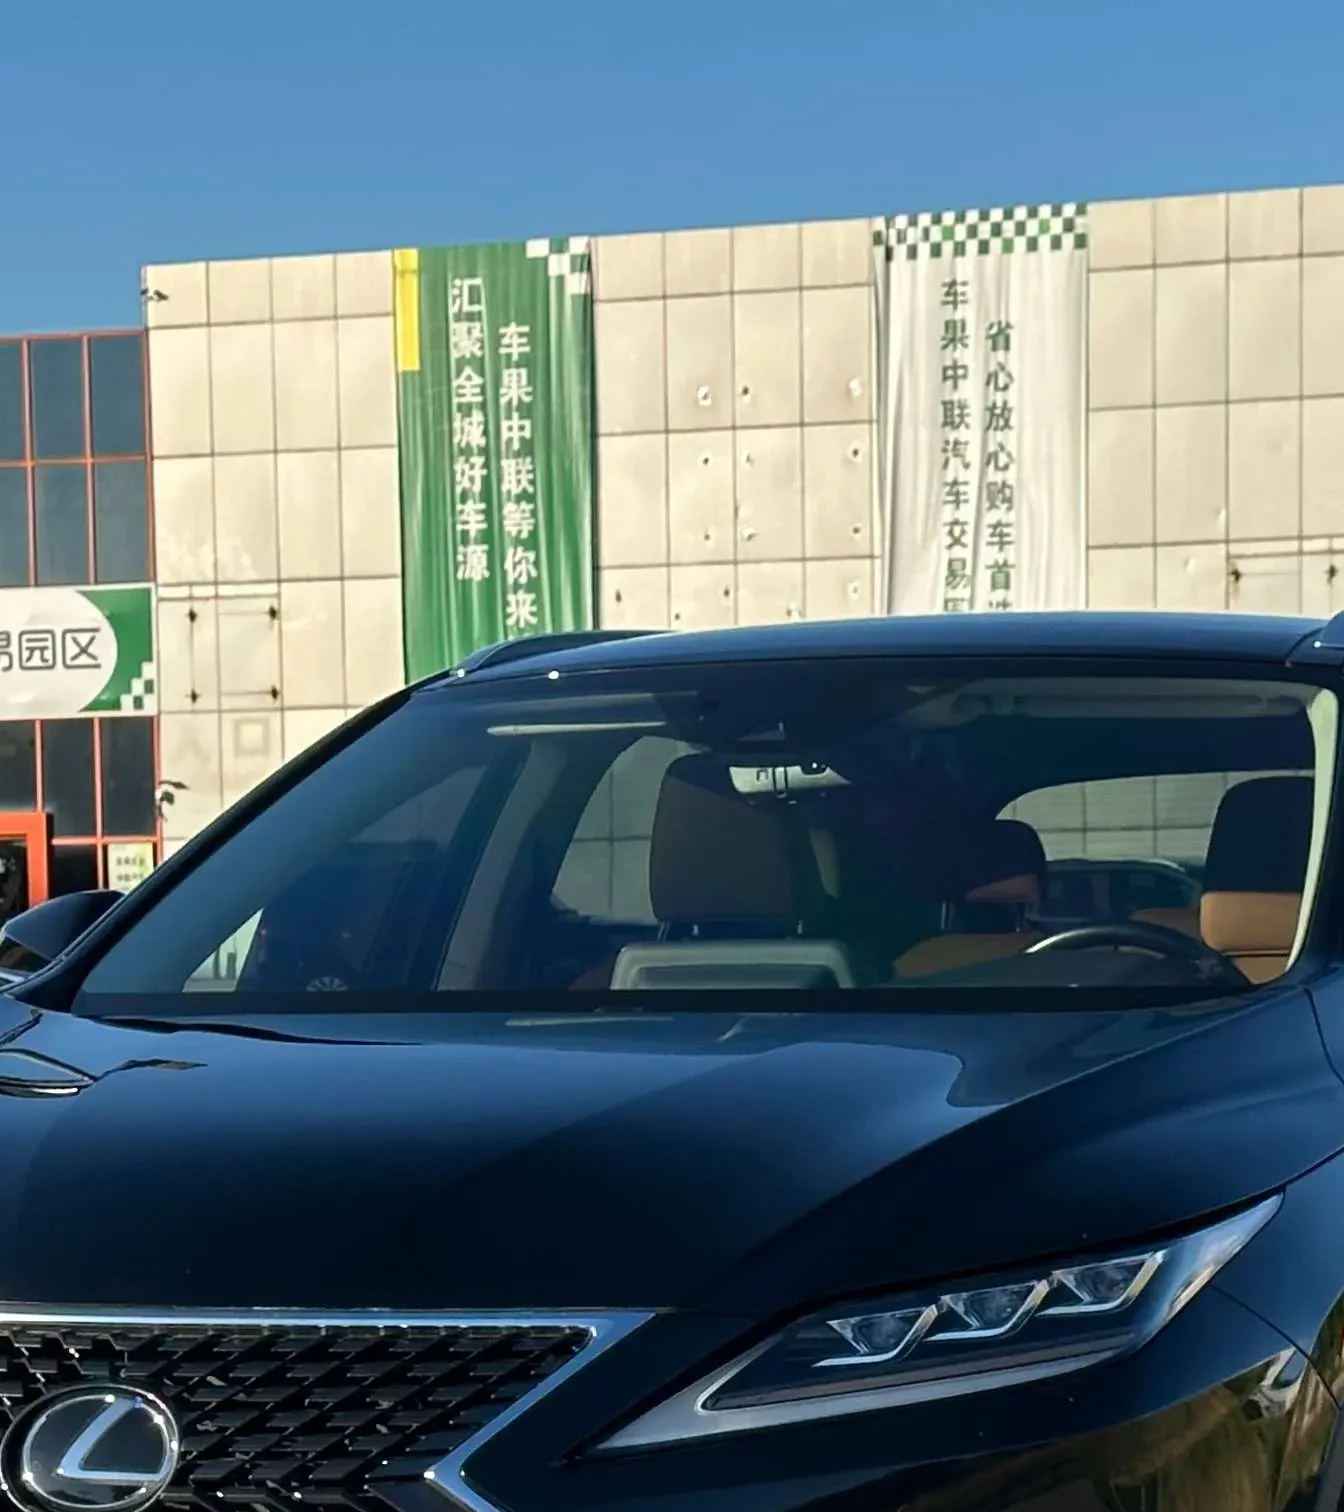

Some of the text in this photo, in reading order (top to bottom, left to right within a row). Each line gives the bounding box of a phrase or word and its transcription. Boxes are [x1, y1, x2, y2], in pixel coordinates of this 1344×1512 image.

[451, 276, 490, 582] 汇聚全城好车源
[498, 321, 539, 629] 车果中联等你来
